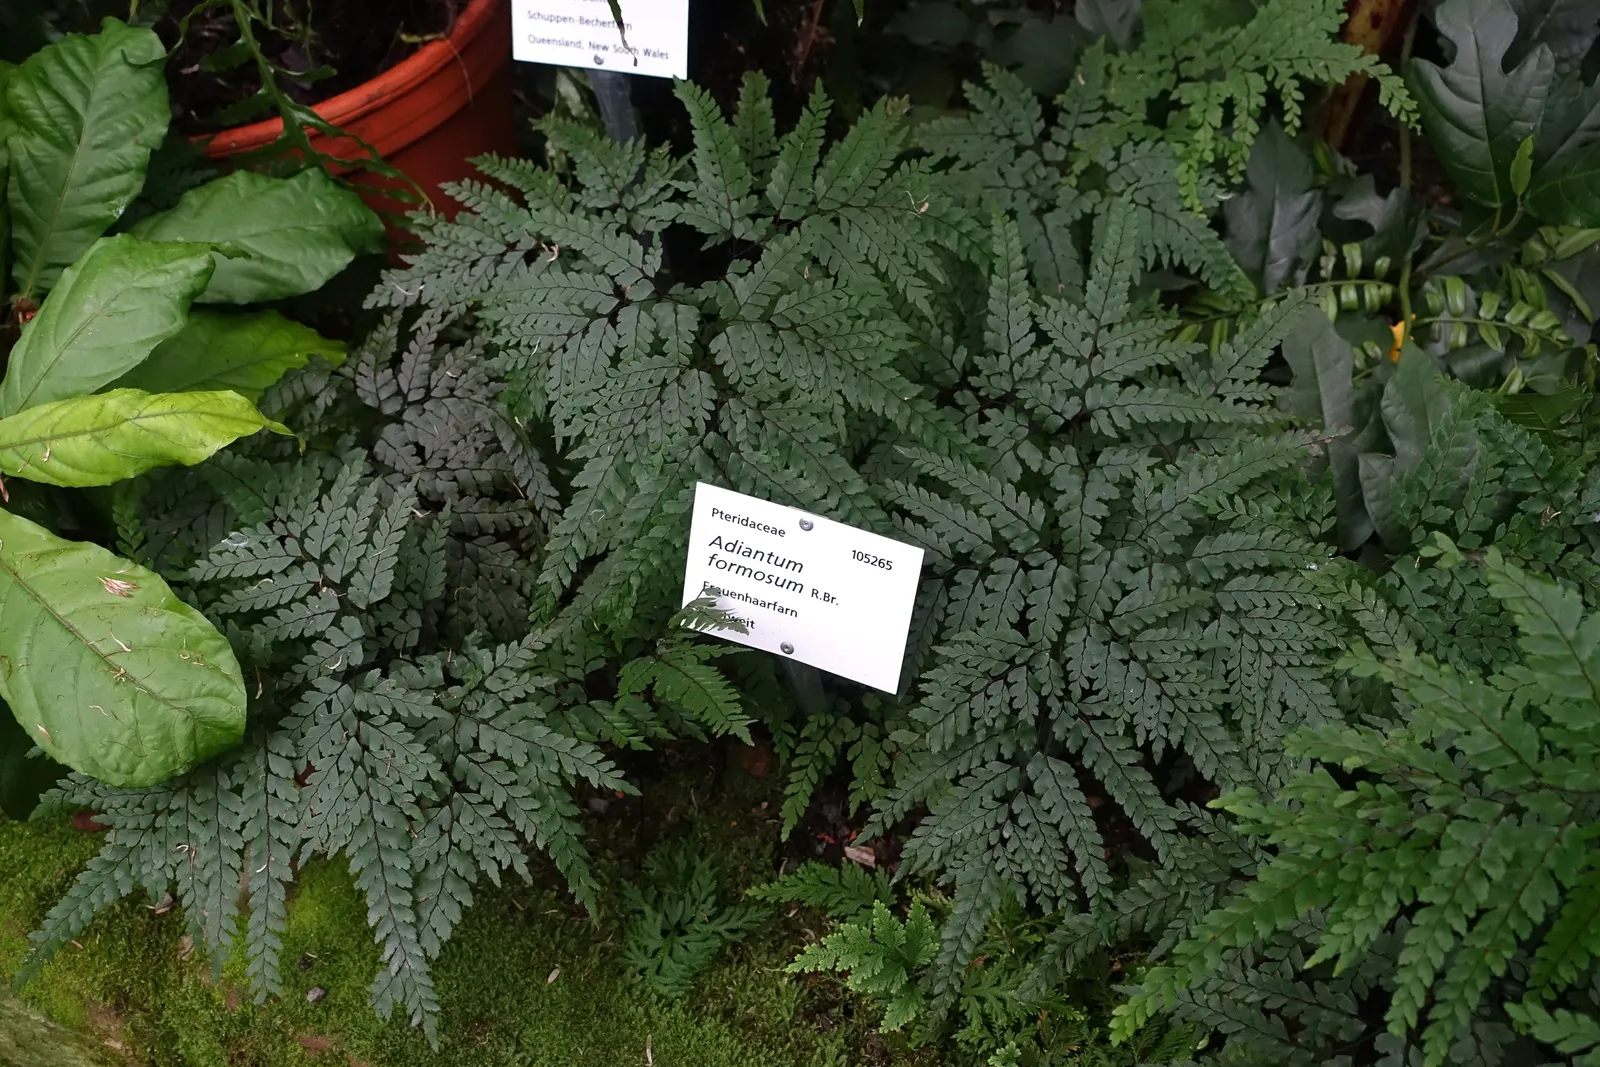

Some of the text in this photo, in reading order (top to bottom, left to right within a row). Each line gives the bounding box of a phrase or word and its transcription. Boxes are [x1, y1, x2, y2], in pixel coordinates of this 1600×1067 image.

[527, 34, 669, 60] Queensland, New South Wales
[711, 507, 786, 538] Pteridaceae
[708, 535, 804, 574] Adiantum
[851, 549, 893, 571] 105265
[707, 553, 839, 606] formosum R.Br.
